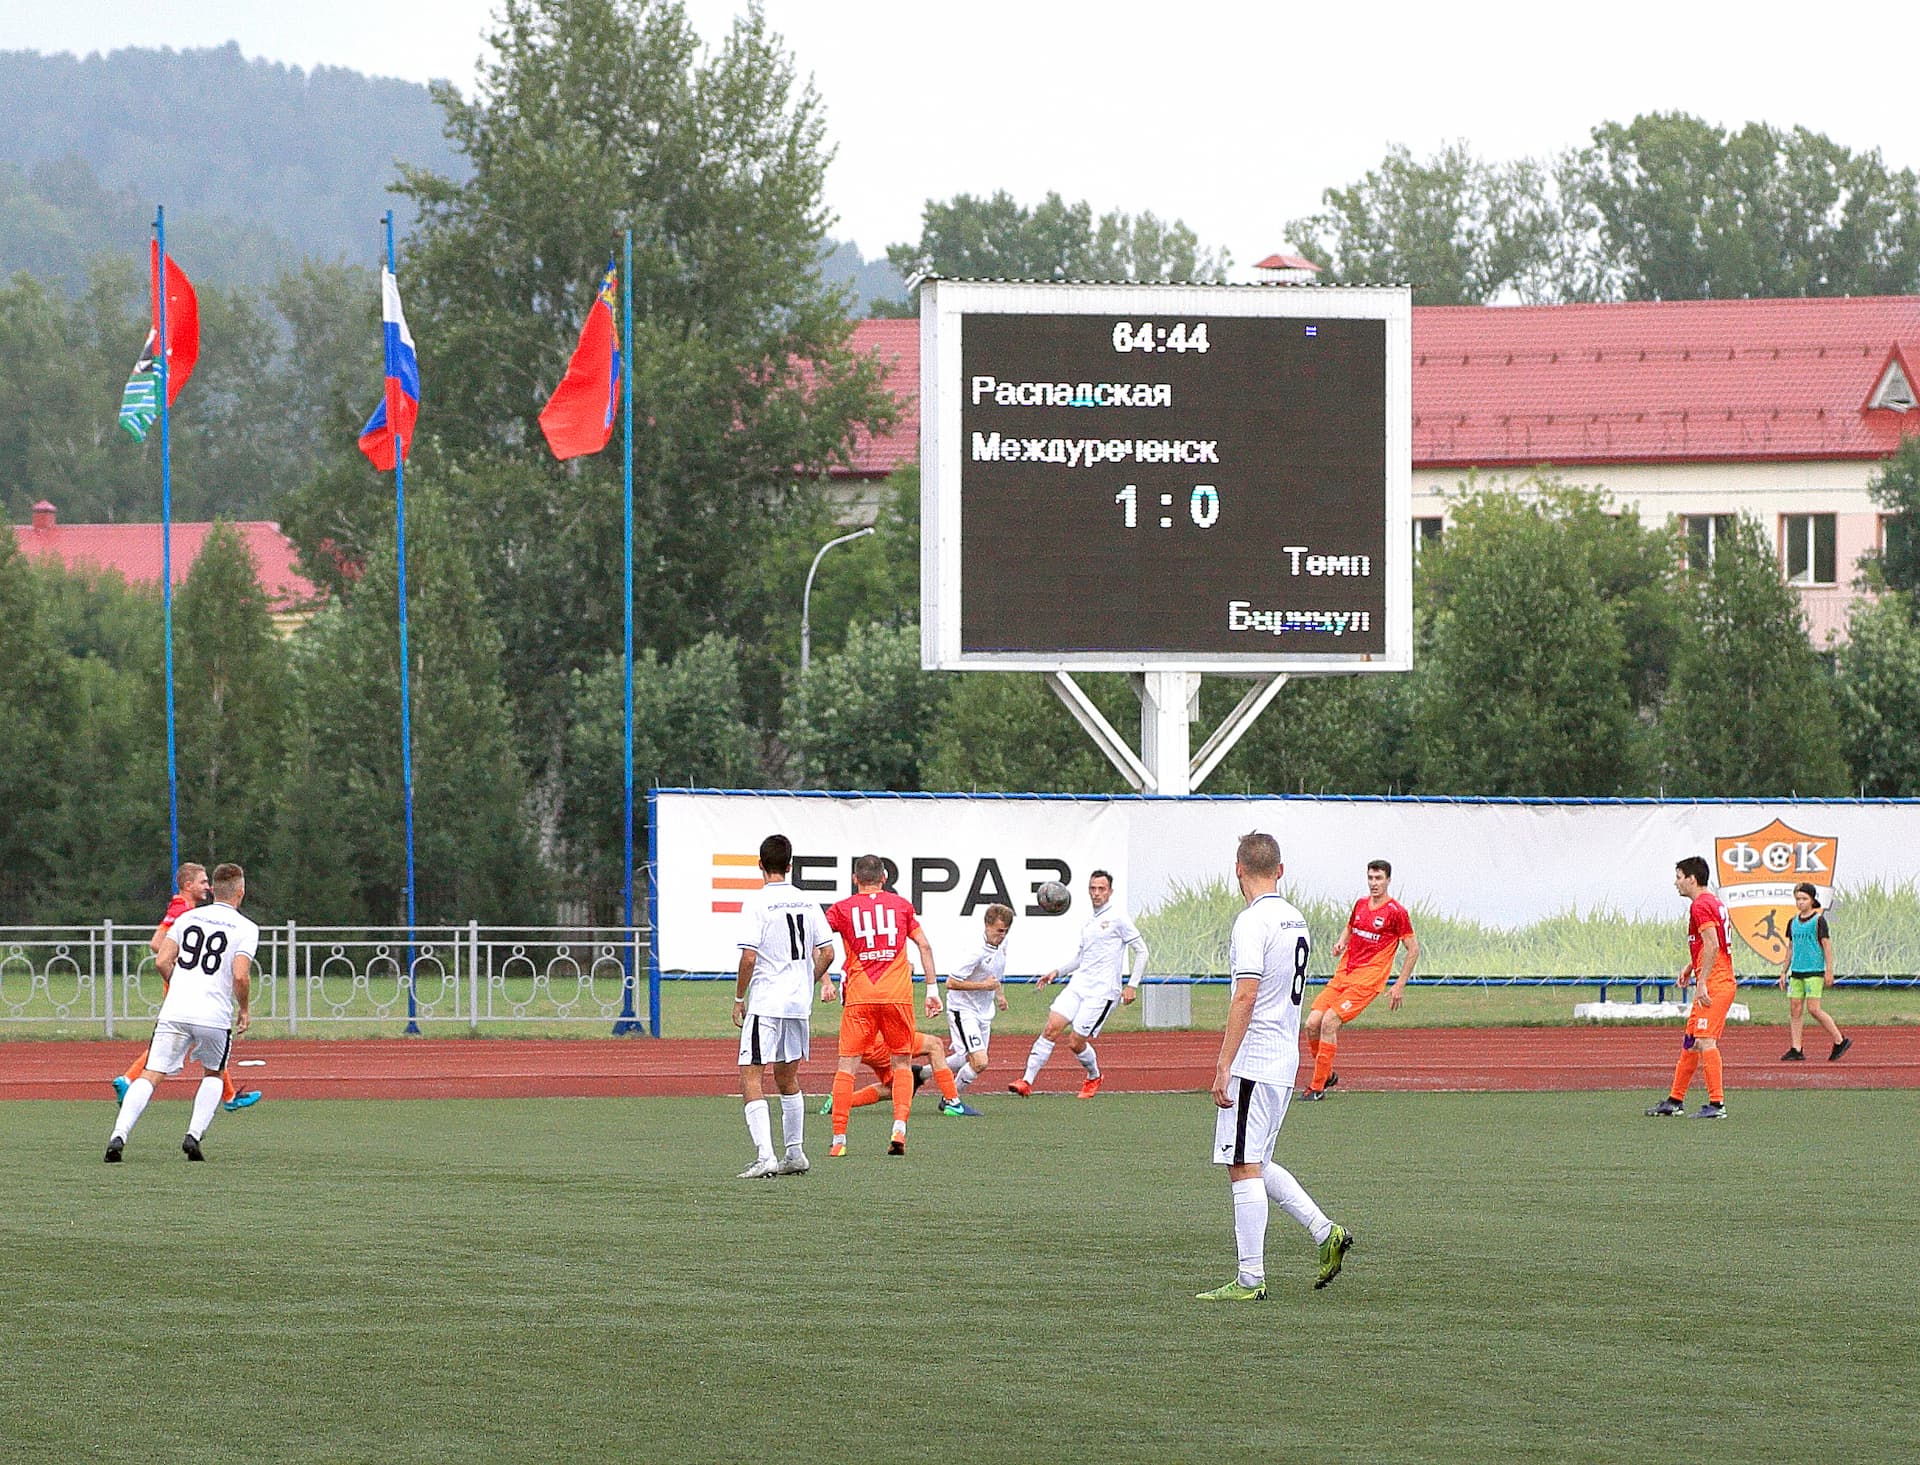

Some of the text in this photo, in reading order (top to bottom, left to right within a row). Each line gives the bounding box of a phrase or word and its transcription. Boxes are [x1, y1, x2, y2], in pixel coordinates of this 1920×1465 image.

[1112, 322, 1210, 353] 64:44
[971, 376, 1172, 407] Распадская
[971, 432, 1220, 467] Междуреченск
[1115, 484, 1137, 528] 1
[1190, 484, 1220, 528] 0
[1722, 842, 1828, 873] ФСК
[851, 903, 898, 948] 44
[178, 925, 228, 975] 98
[1290, 936, 1310, 1006] 8
[968, 1034, 982, 1048] 15
